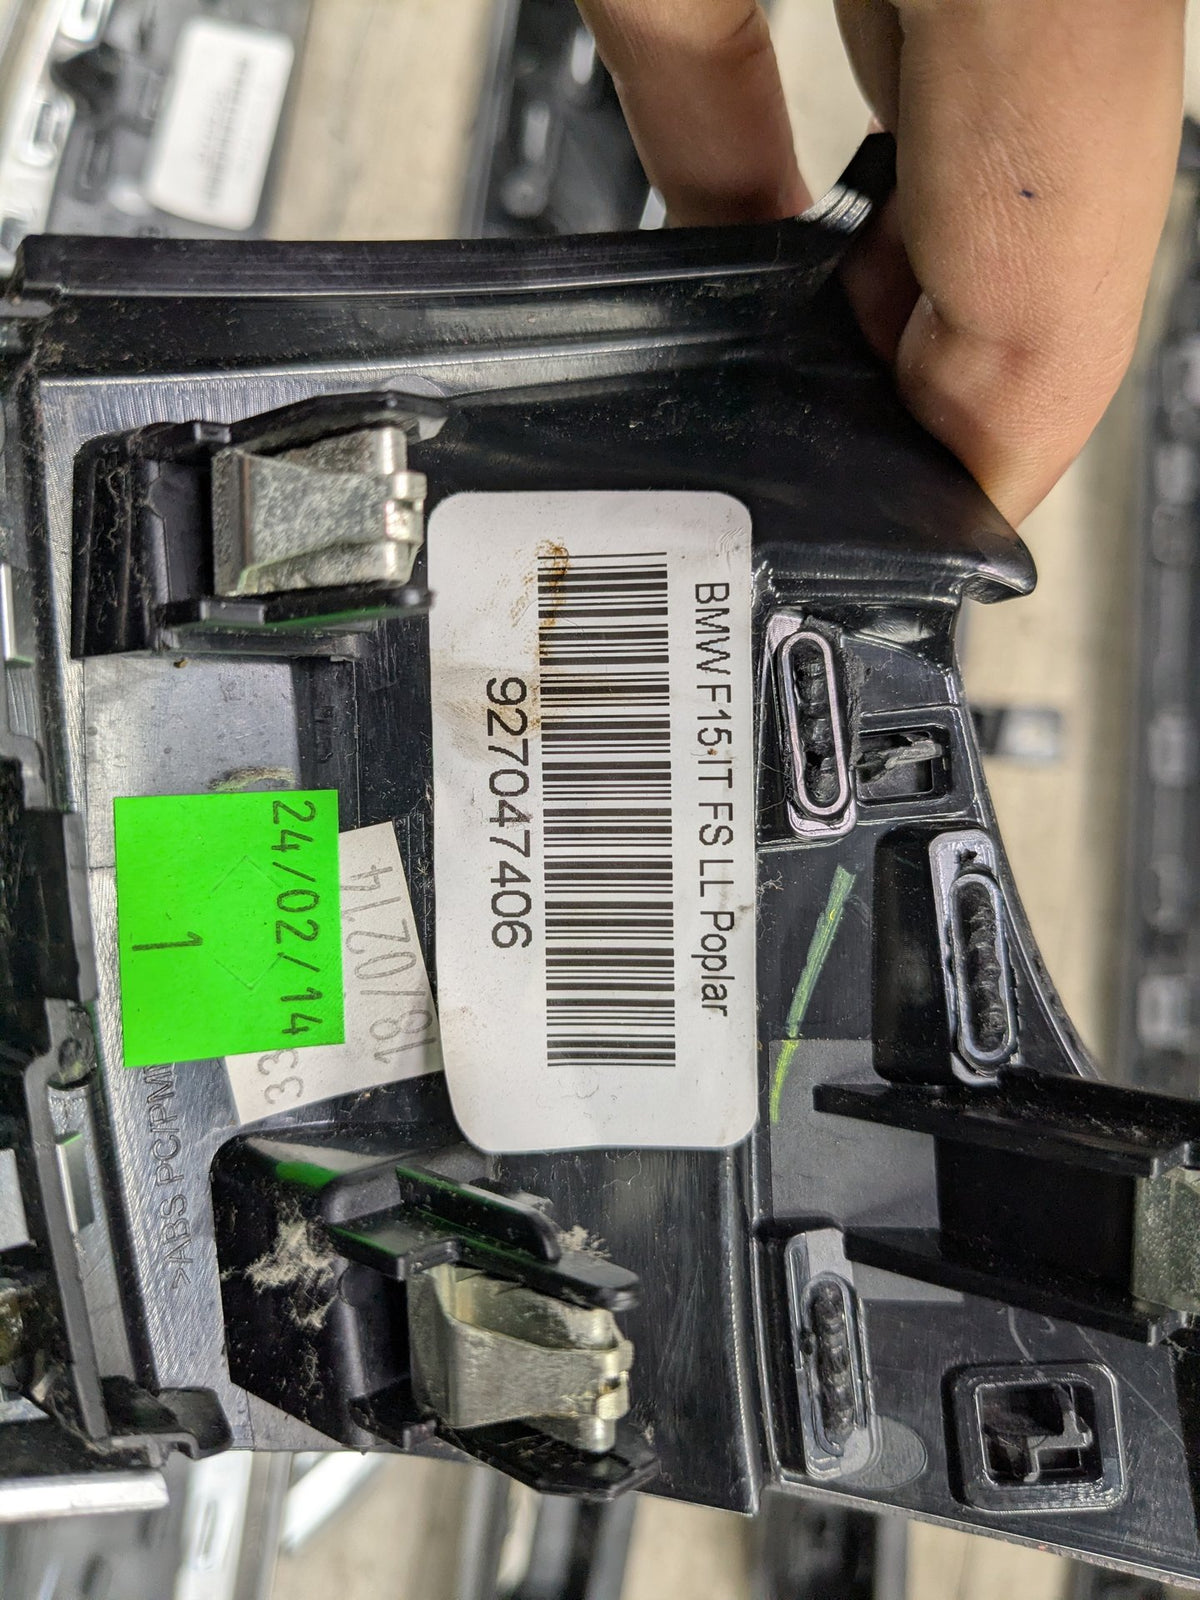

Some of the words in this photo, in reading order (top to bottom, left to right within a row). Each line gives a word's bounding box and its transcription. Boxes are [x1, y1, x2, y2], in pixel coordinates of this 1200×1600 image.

[695, 582, 731, 675] BMW
[696, 684, 732, 747] F15
[697, 759, 733, 789] IT
[486, 677, 532, 948] 927047406
[698, 802, 734, 846] FS
[699, 859, 735, 898] LL
[131, 930, 204, 952] 1
[270, 799, 323, 1036] 24/02/14
[690, 910, 736, 1018] Poplar
